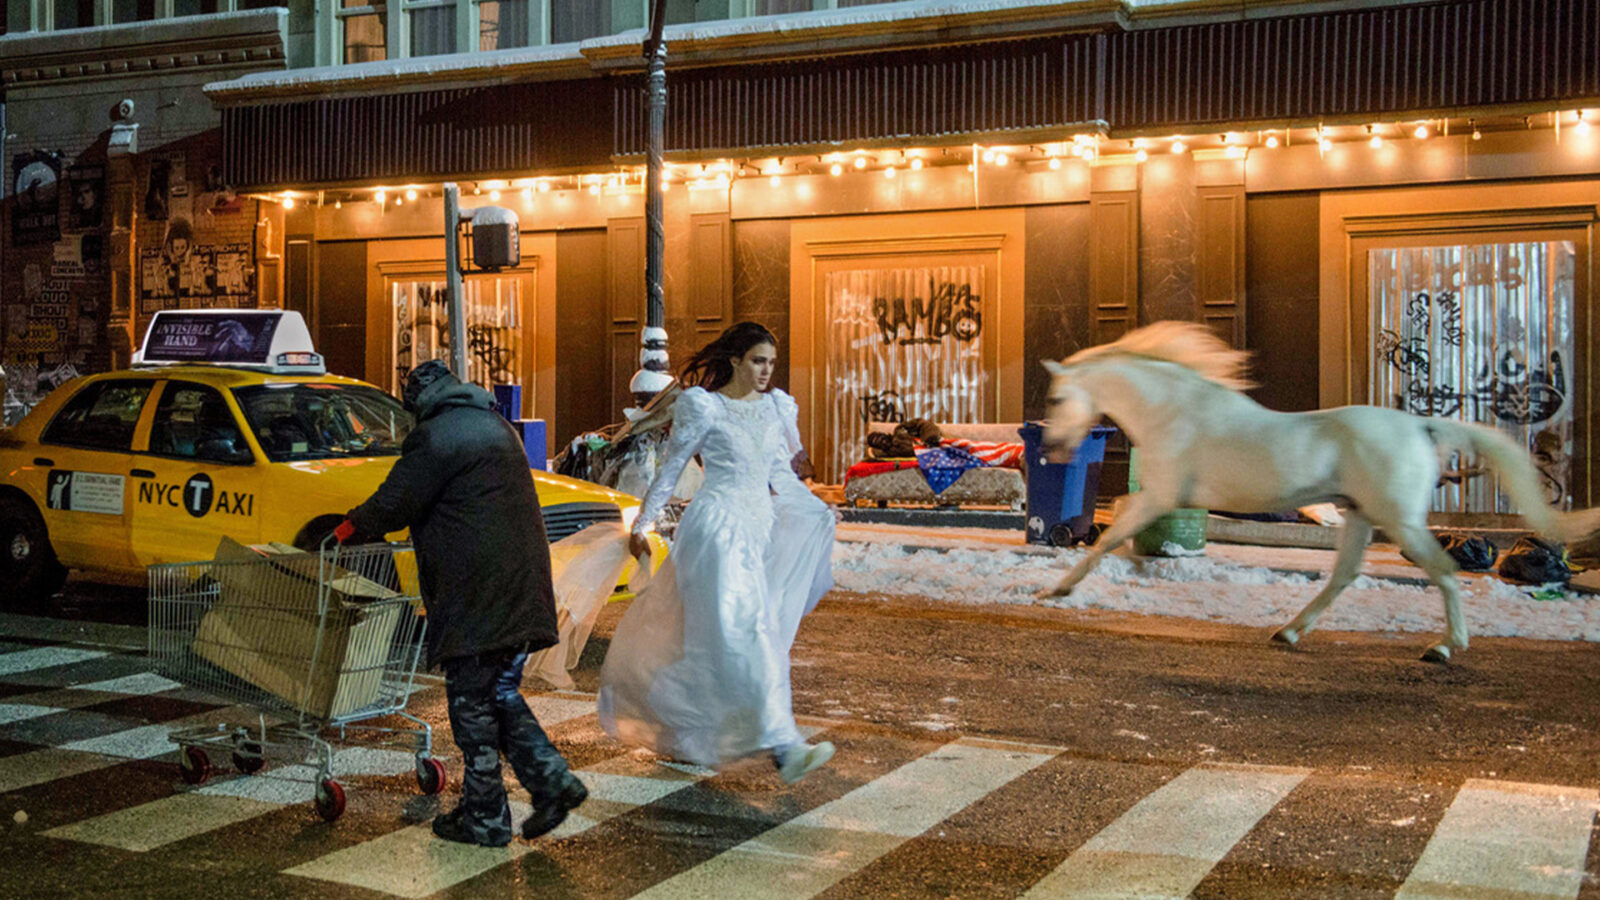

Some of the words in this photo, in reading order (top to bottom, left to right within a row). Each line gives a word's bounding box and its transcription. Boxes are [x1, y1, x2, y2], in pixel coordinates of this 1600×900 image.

[41, 280, 70, 290] HOUT
[156, 323, 213, 335] INVISIBLE
[164, 335, 198, 346] HAND
[139, 482, 180, 508] NYC
